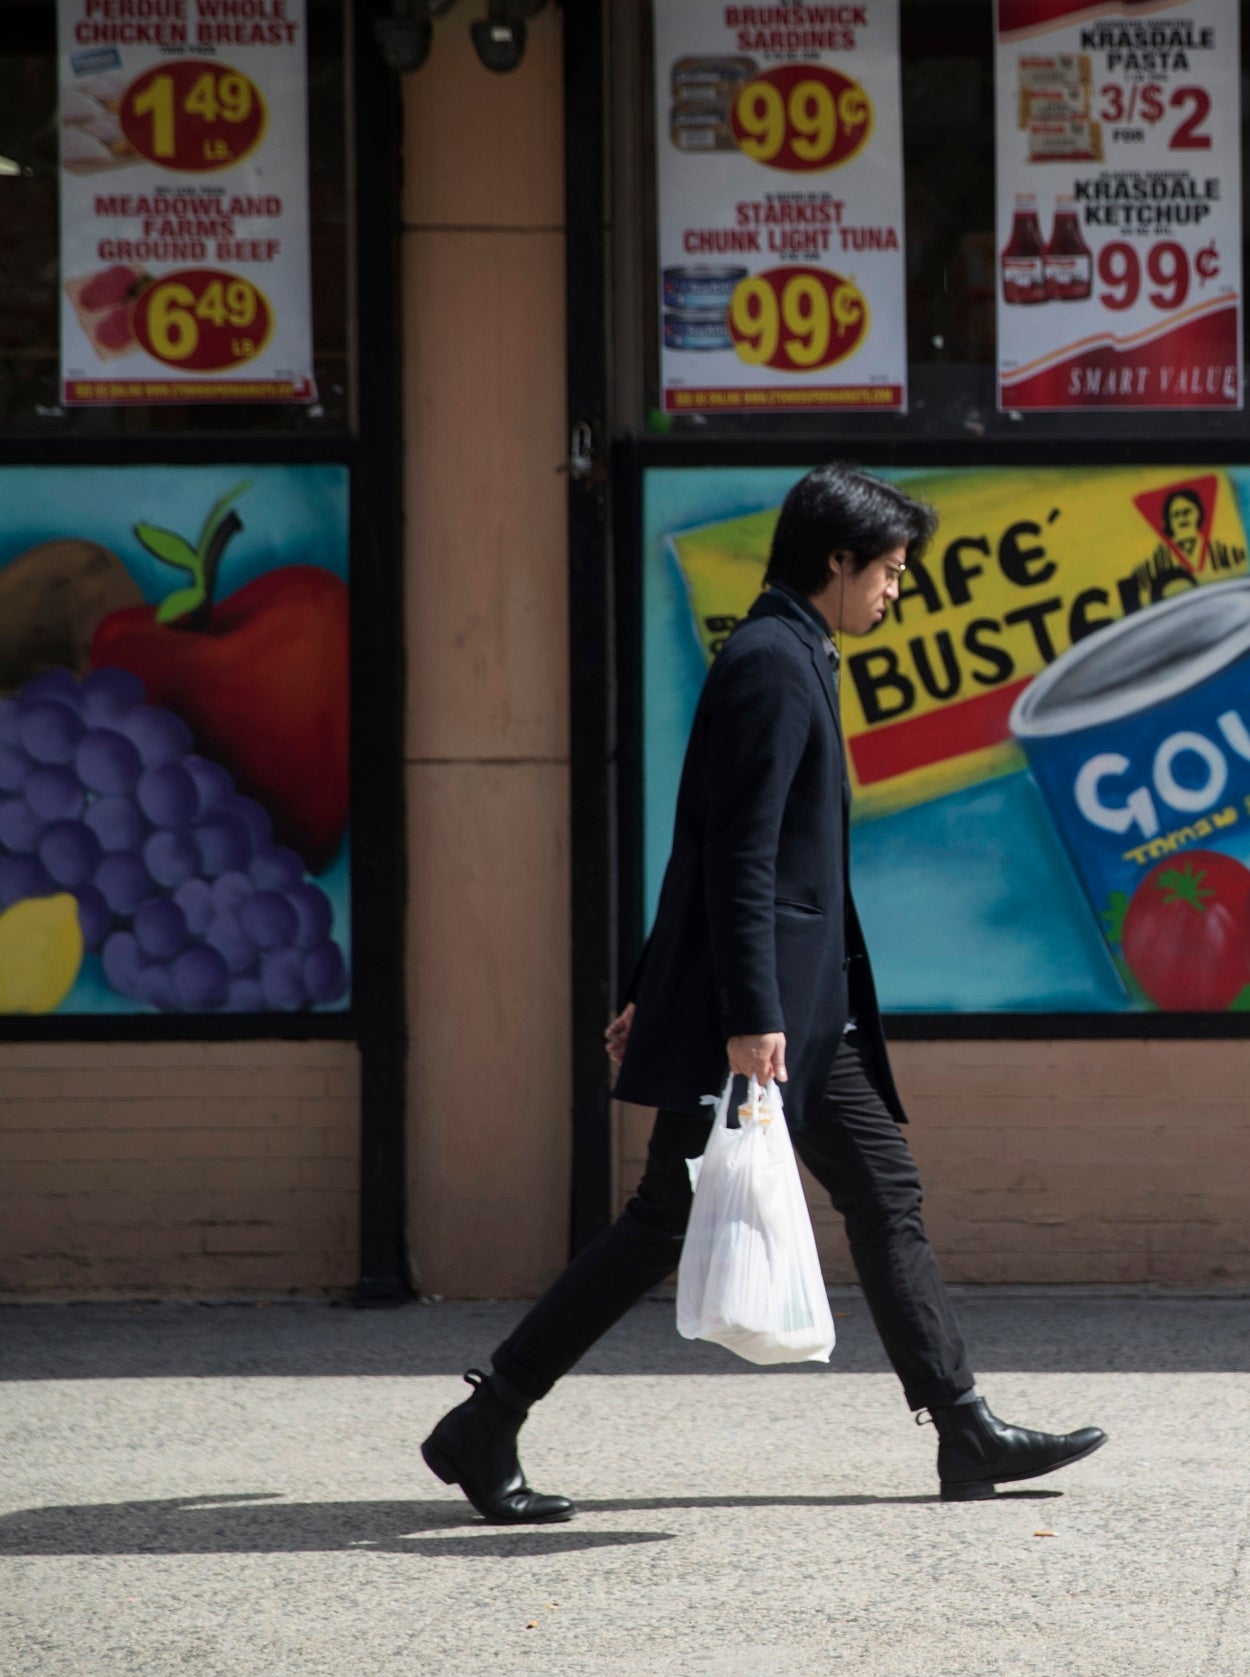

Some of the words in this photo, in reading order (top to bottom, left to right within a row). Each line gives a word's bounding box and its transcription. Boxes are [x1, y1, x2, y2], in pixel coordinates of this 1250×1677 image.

[85, 0, 185, 18] PERDUE
[197, 0, 287, 18] WHOLE
[724, 6, 867, 27] BRUNSWICK
[74, 20, 187, 44] CHICKEN
[196, 21, 297, 45] BREAST
[737, 30, 855, 50] SARDINES
[1080, 27, 1215, 49] KRASDALE
[1107, 51, 1188, 73] PASTA
[1074, 178, 1220, 200] KRASDALE
[94, 194, 282, 217] MEADOWLAND
[735, 201, 844, 225] STARKIST
[1084, 204, 1210, 225] KETCHUP
[143, 217, 235, 238] FARMS
[98, 239, 205, 262] GROUND
[216, 239, 280, 262] BEEF
[683, 228, 760, 253] CHUNK
[768, 228, 831, 252] LIGHT
[838, 226, 899, 251] TUNA
[1068, 366, 1150, 396] SMART
